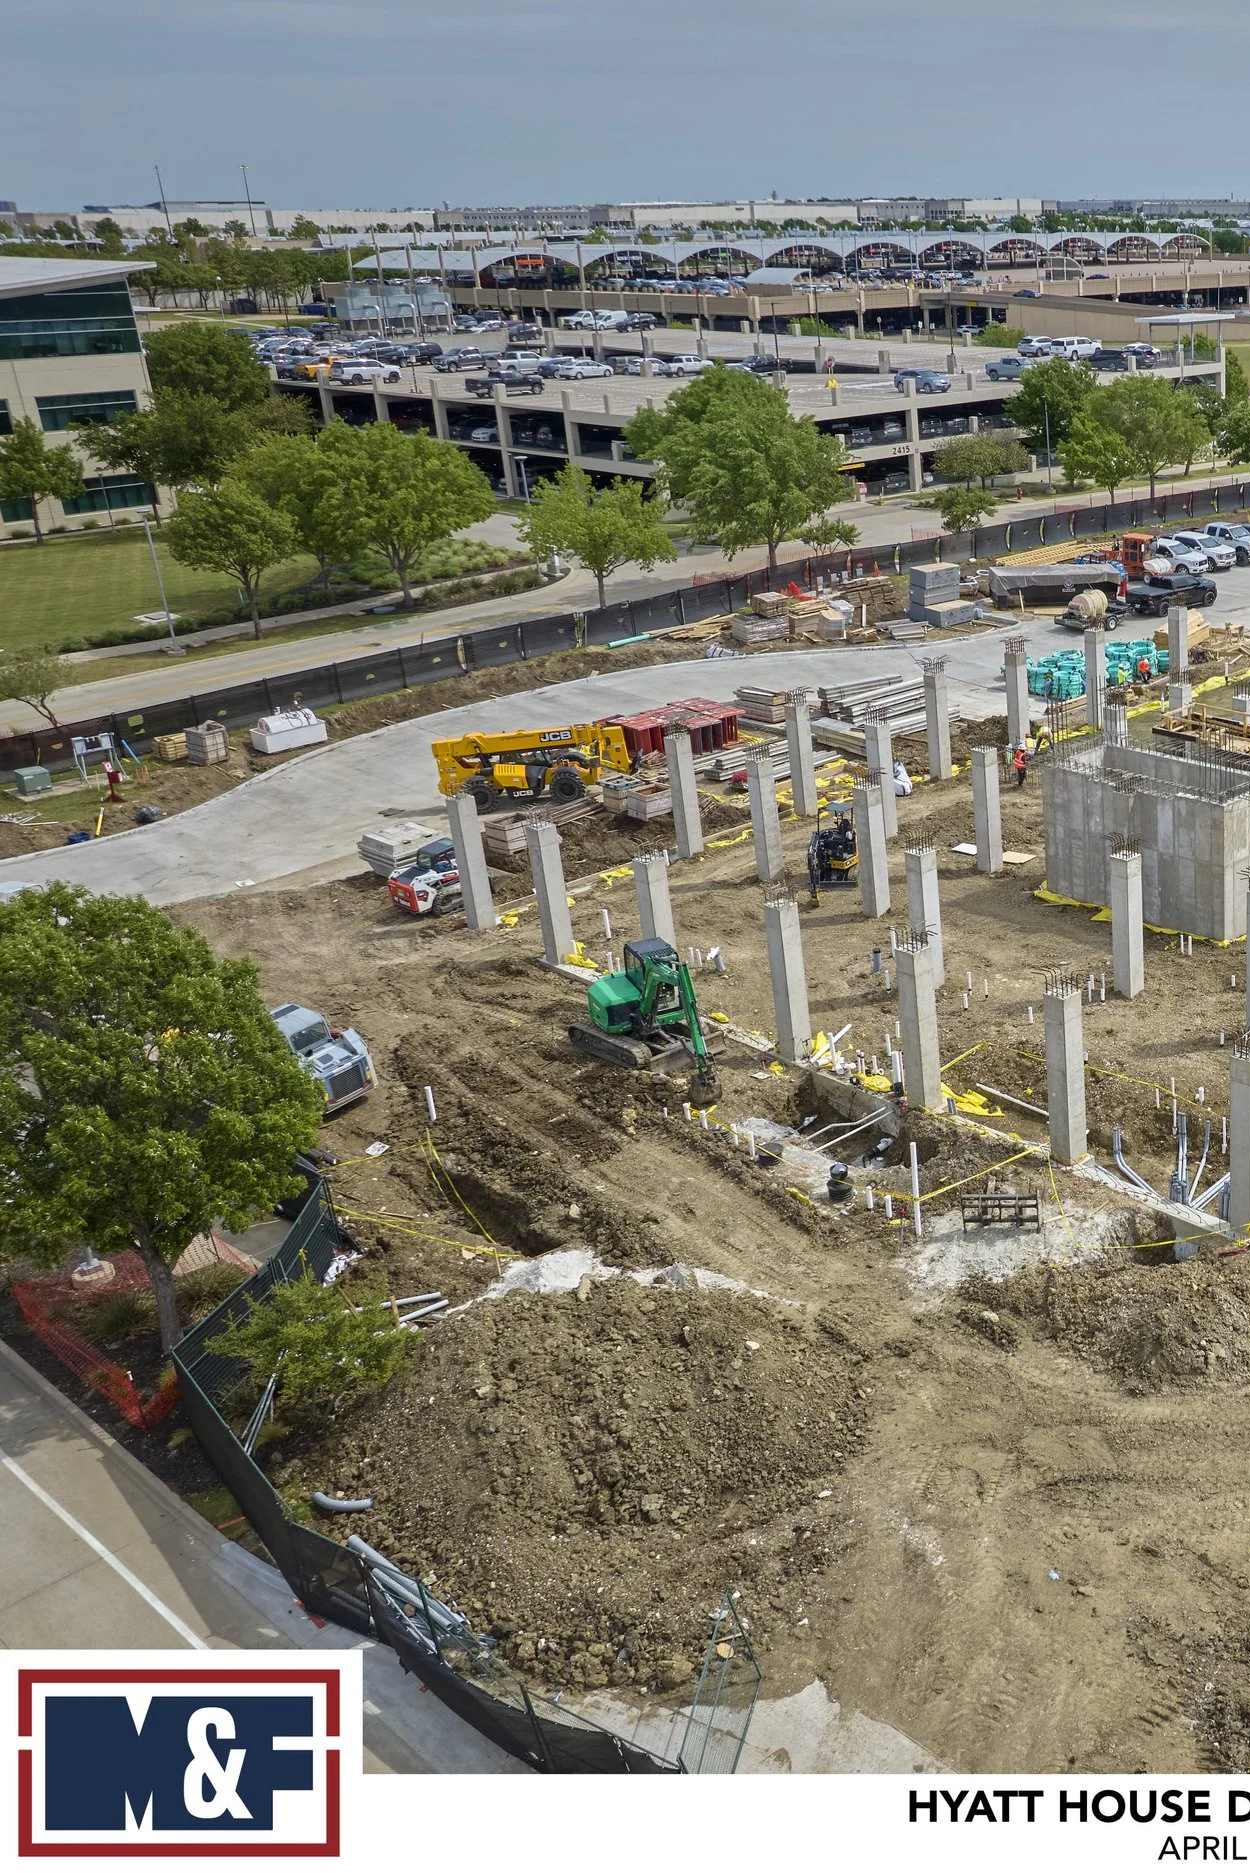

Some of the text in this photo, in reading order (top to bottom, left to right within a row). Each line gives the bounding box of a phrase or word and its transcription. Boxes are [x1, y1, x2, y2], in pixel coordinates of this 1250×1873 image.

[892, 445, 910, 455] 2415
[540, 730, 572, 742] JCB
[512, 789, 533, 798] JCB
